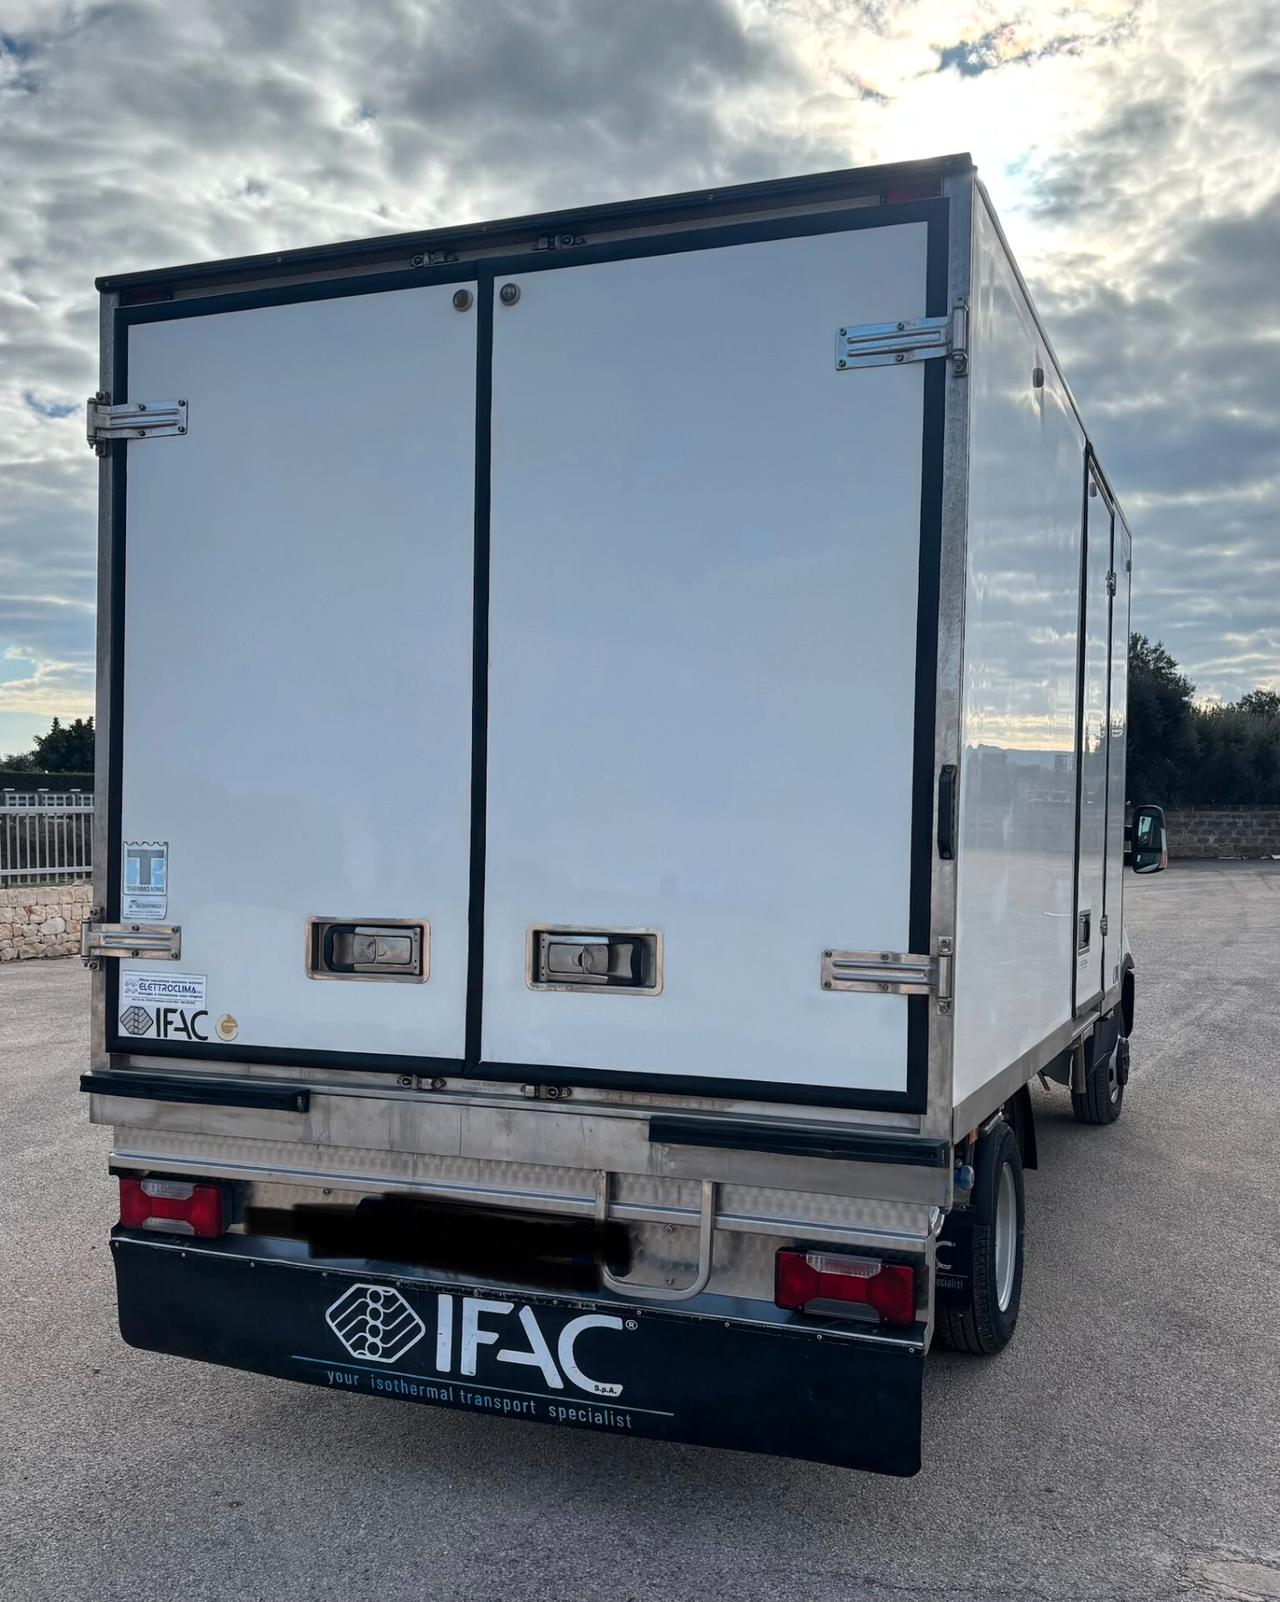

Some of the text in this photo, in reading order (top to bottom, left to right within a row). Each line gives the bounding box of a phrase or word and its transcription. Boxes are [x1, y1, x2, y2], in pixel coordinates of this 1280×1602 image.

[139, 982, 196, 993] ELETTROCLIMA
[156, 1007, 208, 1041] IFAC
[936, 1278, 963, 1290] ecialist
[436, 1294, 623, 1397] IFAC
[327, 1368, 632, 1428] your isothermal transport specialist
[594, 1384, 617, 1395] S.p.A.
